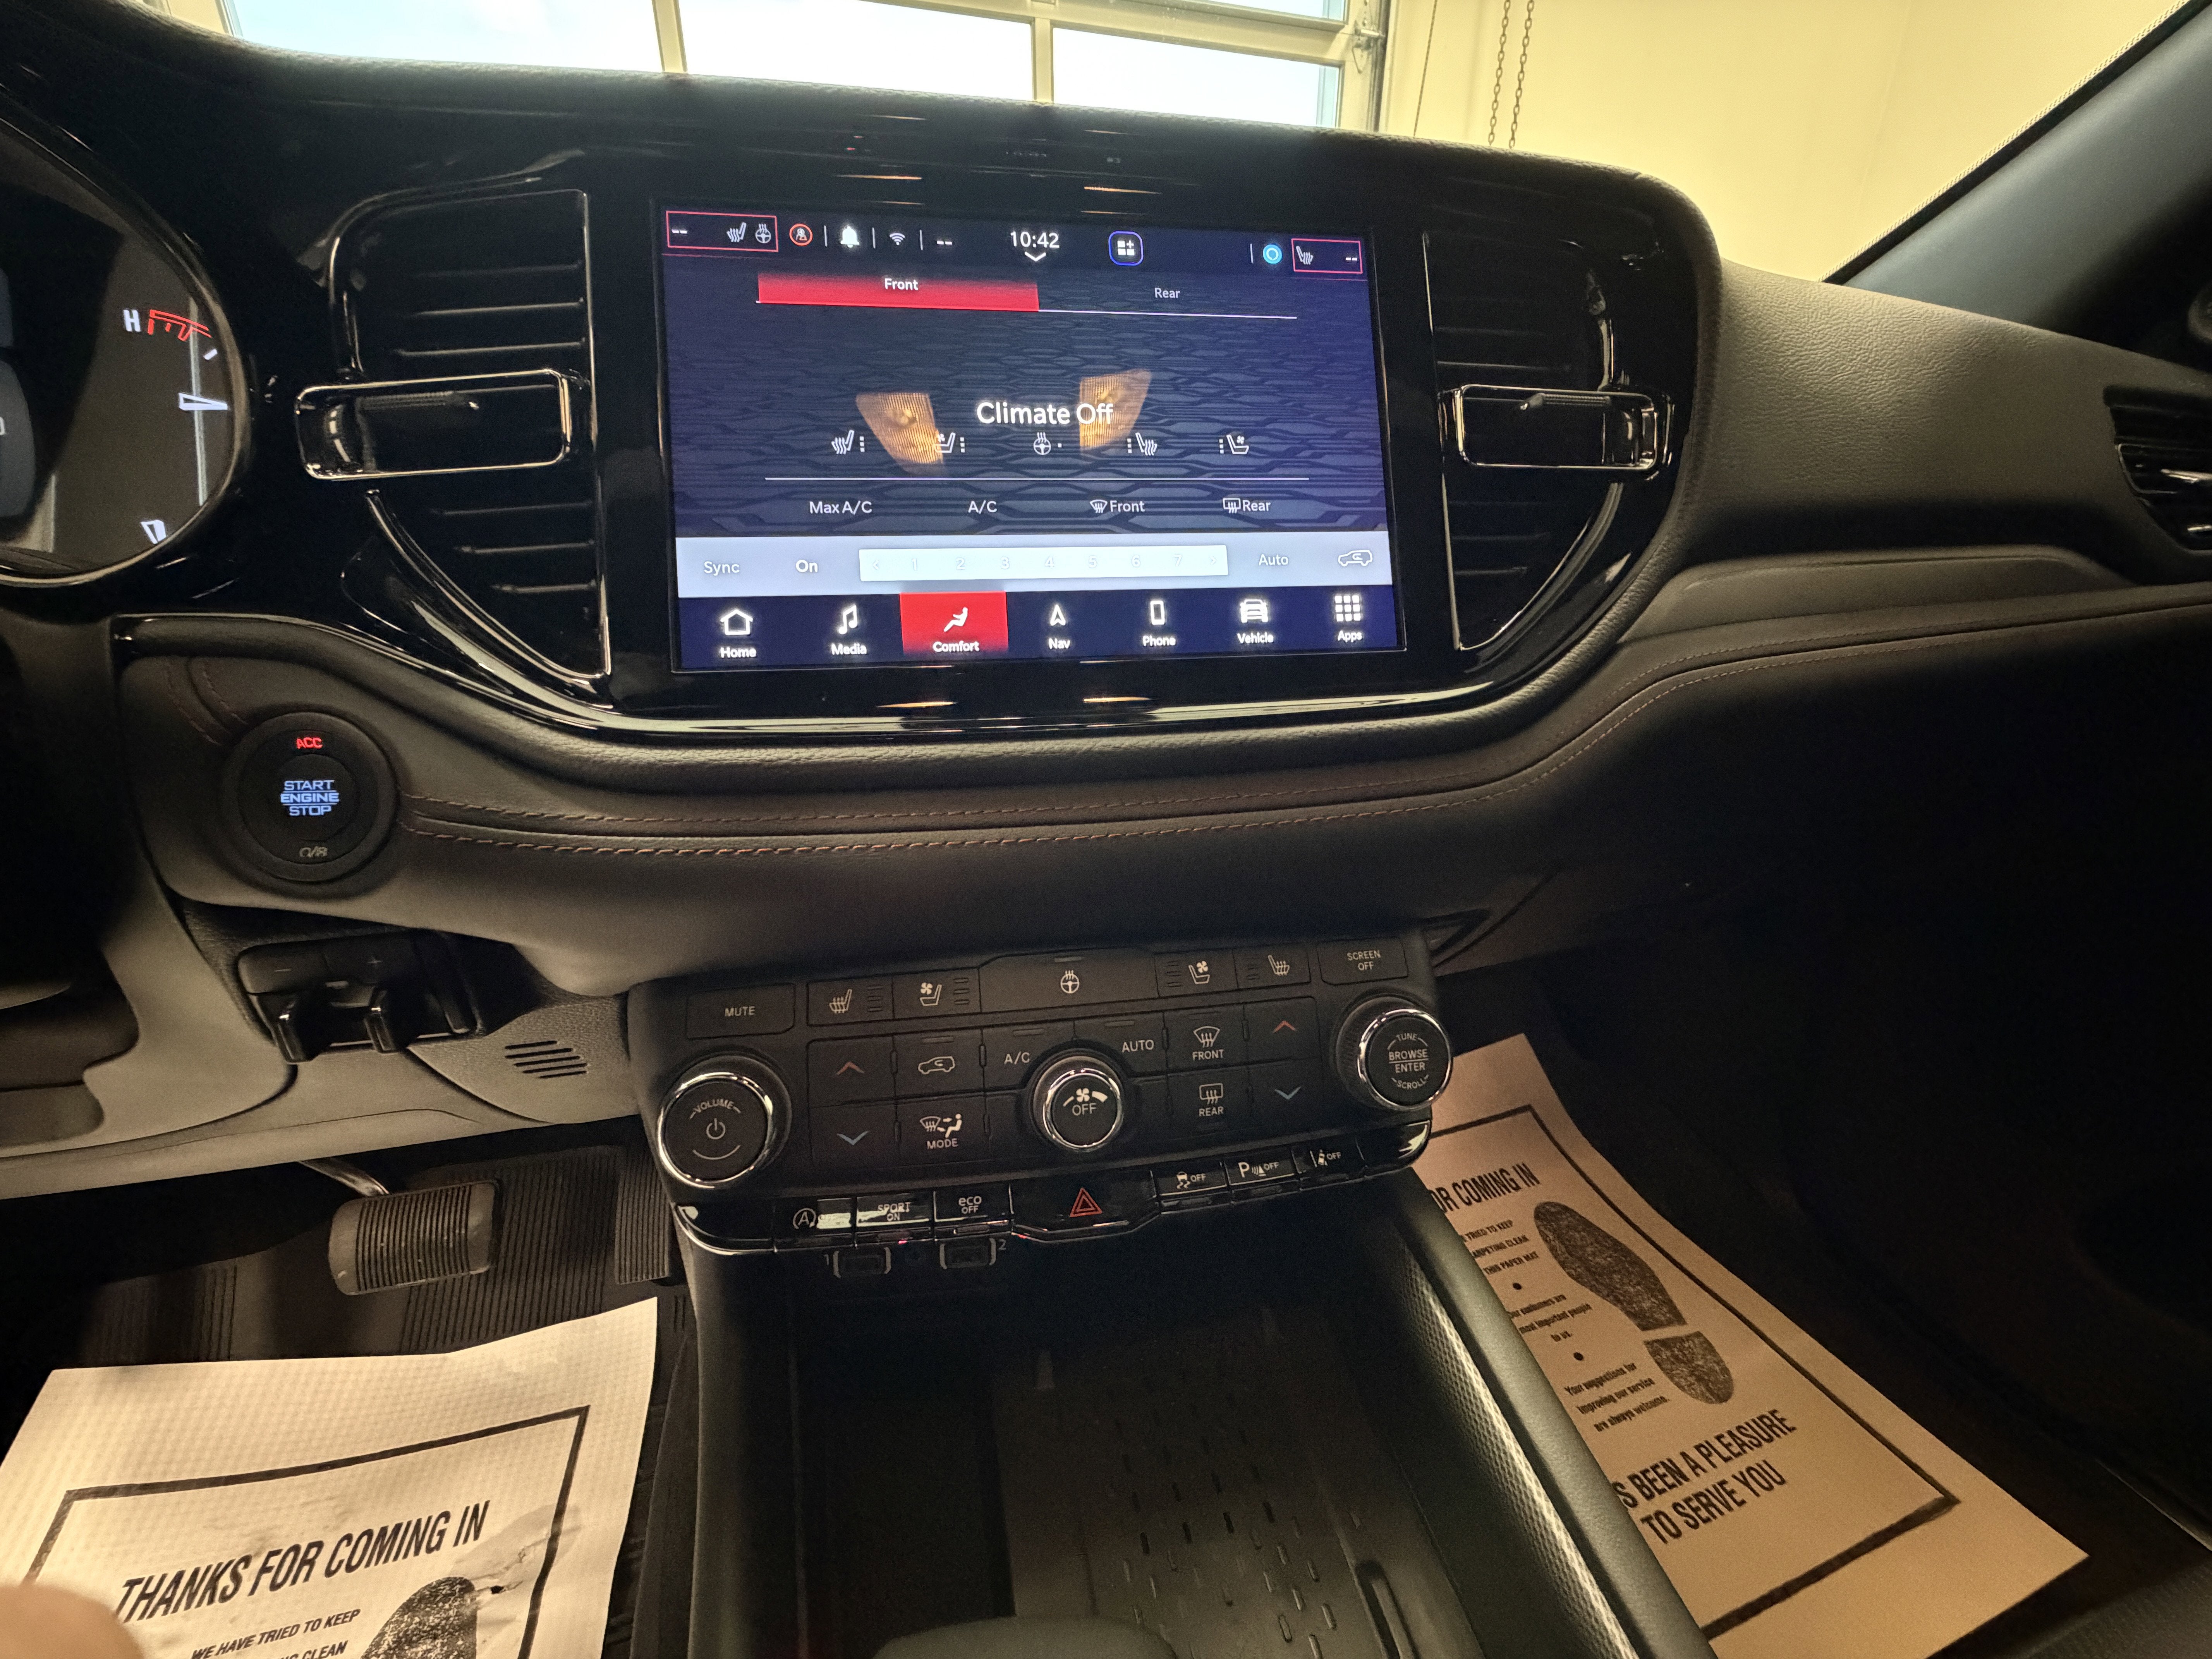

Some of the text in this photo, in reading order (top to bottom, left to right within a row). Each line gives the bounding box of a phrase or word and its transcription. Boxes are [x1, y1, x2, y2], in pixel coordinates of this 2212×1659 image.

[1012, 231, 1060, 249] 10:42
[884, 278, 919, 291] Front
[1154, 287, 1180, 298] Rear
[123, 309, 141, 332] H
[976, 402, 1113, 424] Climate Off
[809, 501, 872, 515] Max A/C
[968, 500, 997, 514] A/C
[1109, 500, 1145, 513] Front
[1242, 500, 1271, 512] Rear
[956, 558, 965, 570] 2
[1001, 557, 1010, 570] 3
[1044, 555, 1055, 568] 4
[1131, 555, 1141, 567] 6
[1258, 553, 1289, 566] Auto
[704, 561, 740, 576] Sync
[795, 559, 818, 573] On
[1142, 634, 1176, 647] Phone
[1237, 632, 1274, 644] Vehicle
[1337, 630, 1362, 643] Apps
[831, 644, 867, 655] Media
[933, 641, 980, 653] Comfort
[1049, 638, 1070, 649] Nav
[720, 647, 757, 658] Home
[296, 737, 323, 749] ACC
[284, 780, 335, 791] START
[280, 792, 340, 803] ENGINE
[289, 805, 332, 816] STOP
[1347, 950, 1381, 961] SCREEN
[1357, 961, 1374, 971] OFF
[724, 1006, 756, 1017] MUTE
[1396, 1033, 1418, 1041] TUNE
[1121, 1039, 1155, 1053] AUTO
[1004, 1052, 1030, 1065] A/C
[1192, 1049, 1224, 1060] FRONT
[1389, 1049, 1428, 1061] BROWSE
[1395, 1062, 1425, 1073] ENTER
[1396, 1079, 1426, 1090] SCROLL
[693, 1098, 735, 1113] VOLUME
[1072, 1103, 1097, 1116] OFF
[1199, 1106, 1224, 1117] REAR
[927, 1139, 958, 1149] MODE
[1326, 1152, 1341, 1160] OFF
[1263, 1162, 1279, 1171] OFF
[1190, 1173, 1206, 1183] OFF
[1427, 1162, 1540, 1213] OR COMING IN
[878, 1202, 911, 1213] SPORT
[958, 1196, 982, 1207] eco
[961, 1205, 979, 1214] OFF
[886, 1213, 900, 1221] ON
[1693, 1408, 1796, 1469] PLEASURE
[1680, 1451, 1708, 1477] A
[1628, 1457, 1690, 1501] BEEN
[1640, 1510, 1683, 1545] TO
[1671, 1479, 1747, 1530] SERVE
[1731, 1459, 1787, 1498] YOU
[115, 1500, 491, 1624] THANKS FOR COMING IN
[191, 1608, 361, 1659] WE HAVE TRIED TO KEEP
[302, 1640, 349, 1659] CLEAN
